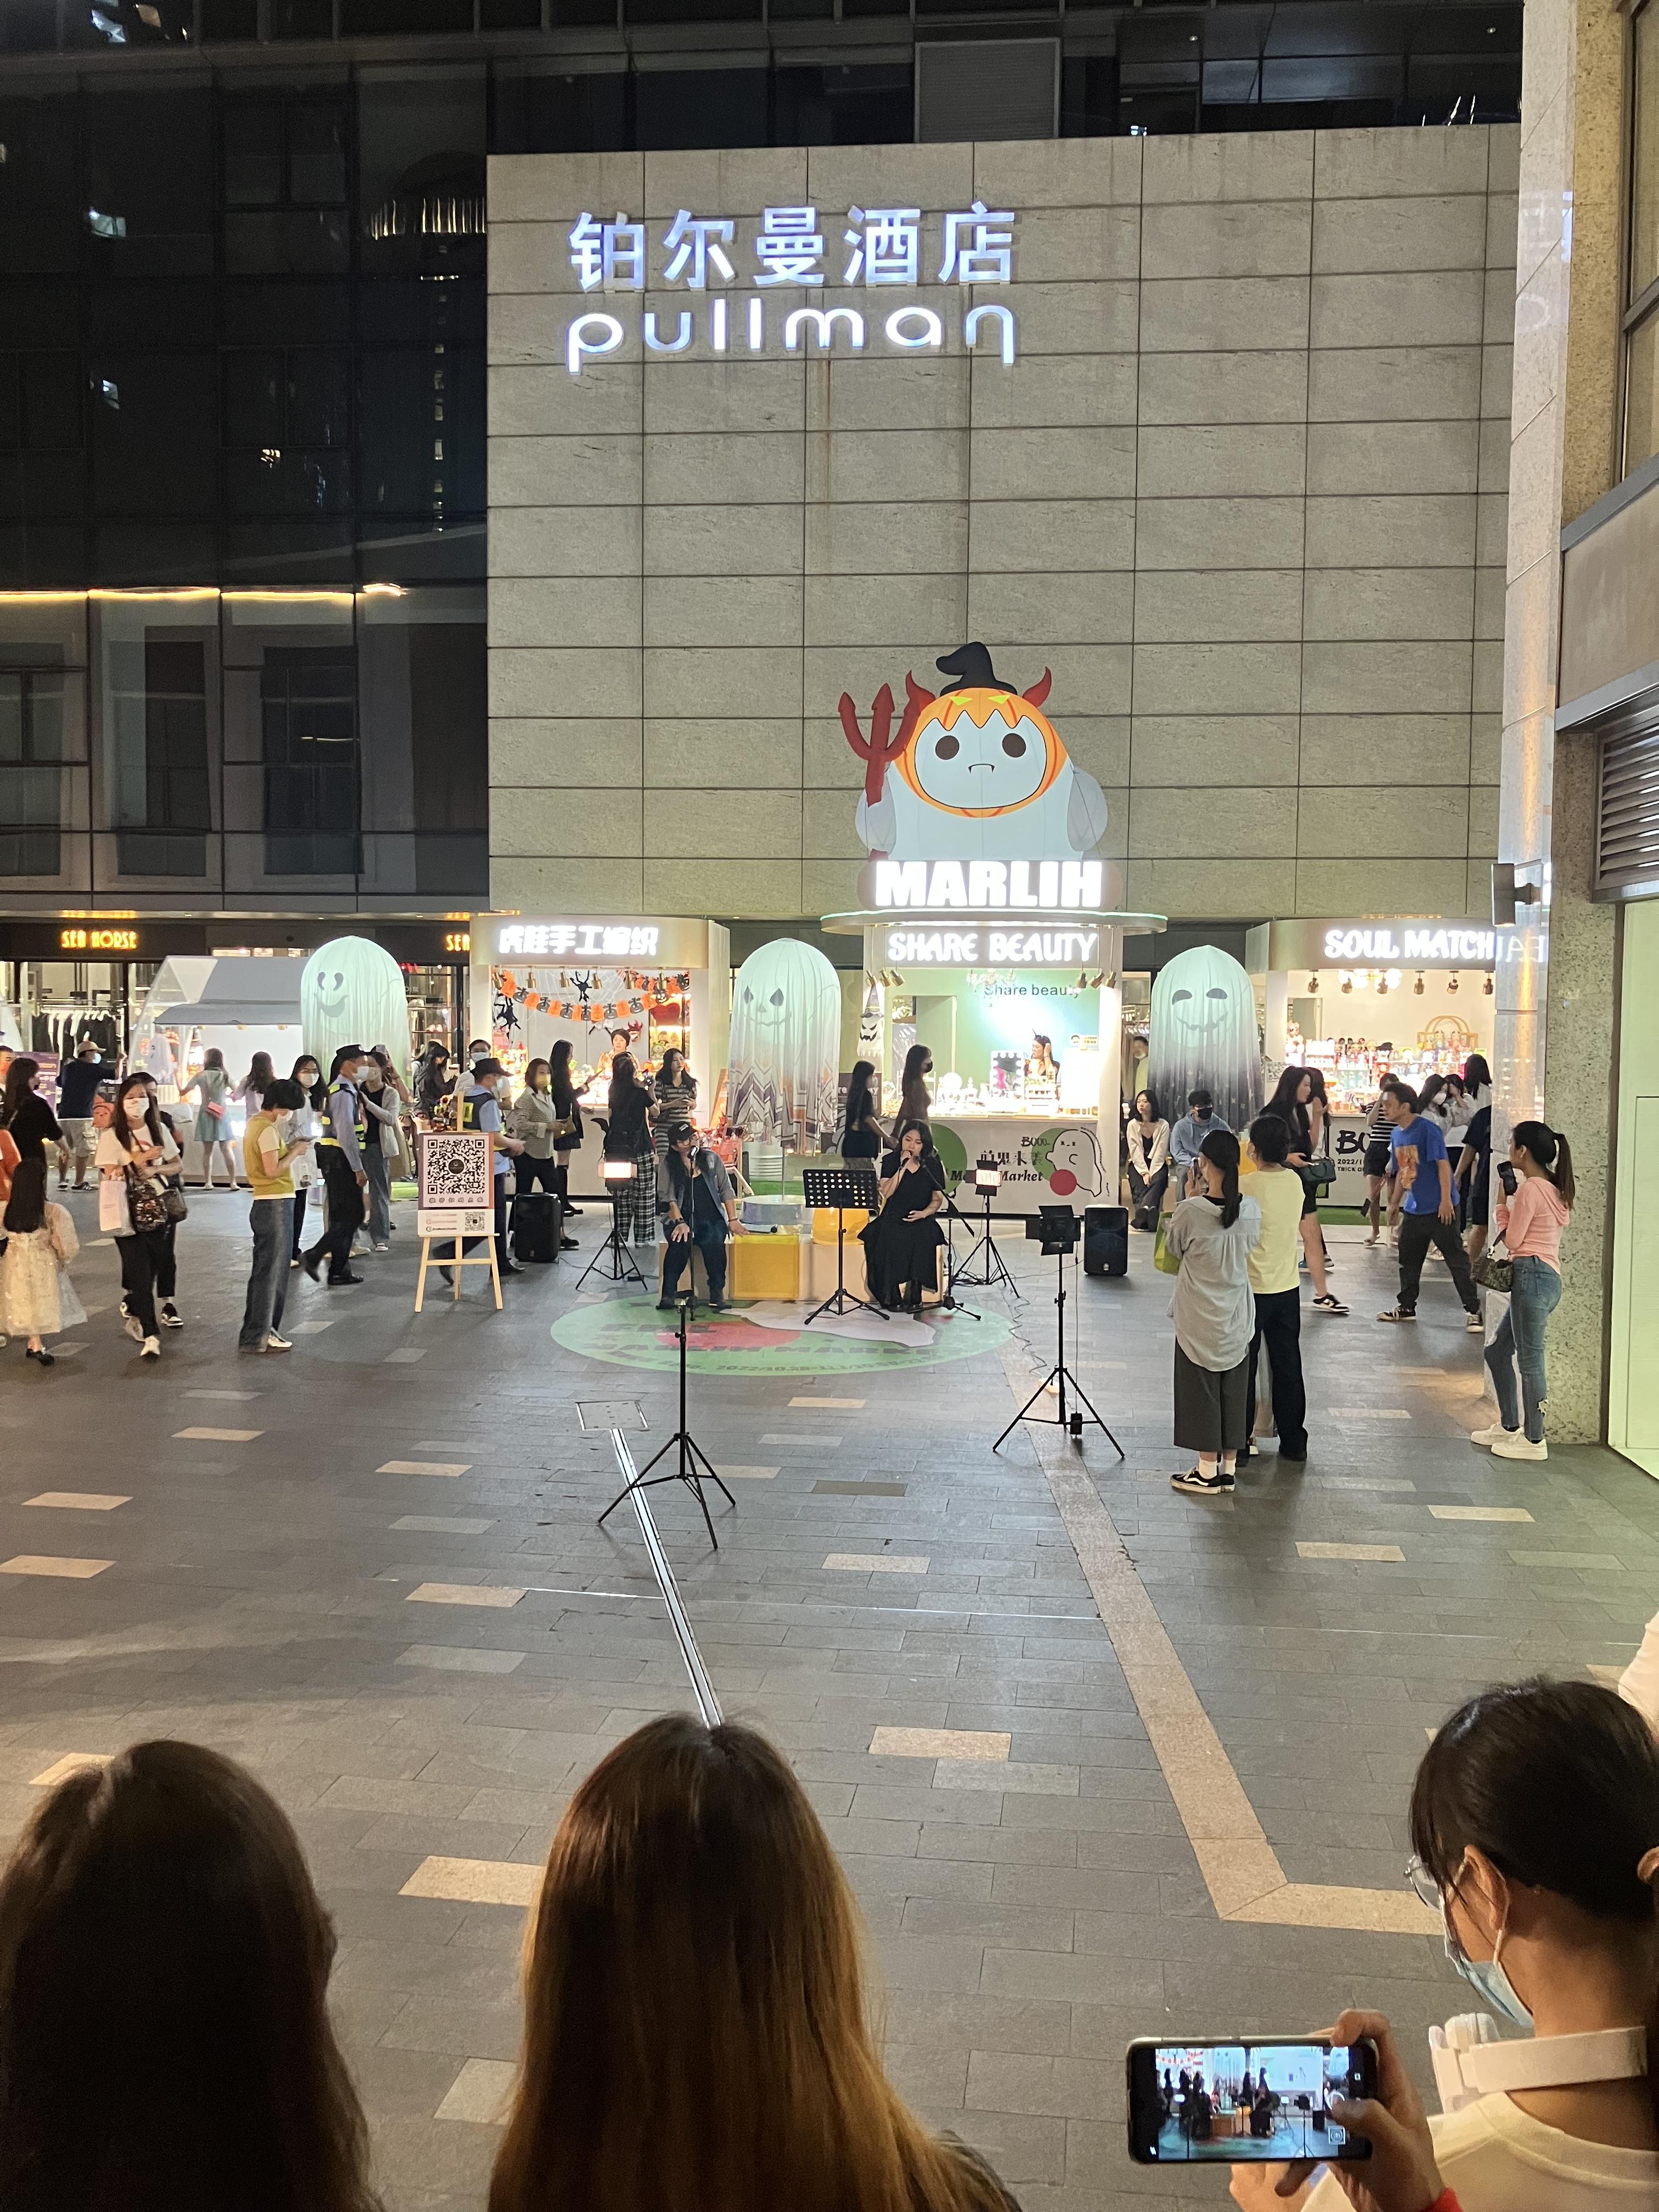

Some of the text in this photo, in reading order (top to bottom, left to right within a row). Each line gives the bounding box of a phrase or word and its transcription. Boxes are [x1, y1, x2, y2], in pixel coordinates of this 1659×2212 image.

[568, 201, 1015, 292] 铂尔曼酒店
[567, 298, 1016, 375] pullman
[876, 860, 1103, 907] MARLIH
[91, 930, 137, 949] HORSE
[887, 933, 1099, 962] SHARE BEAUTY
[1324, 929, 1495, 960] SOUL MATCH
